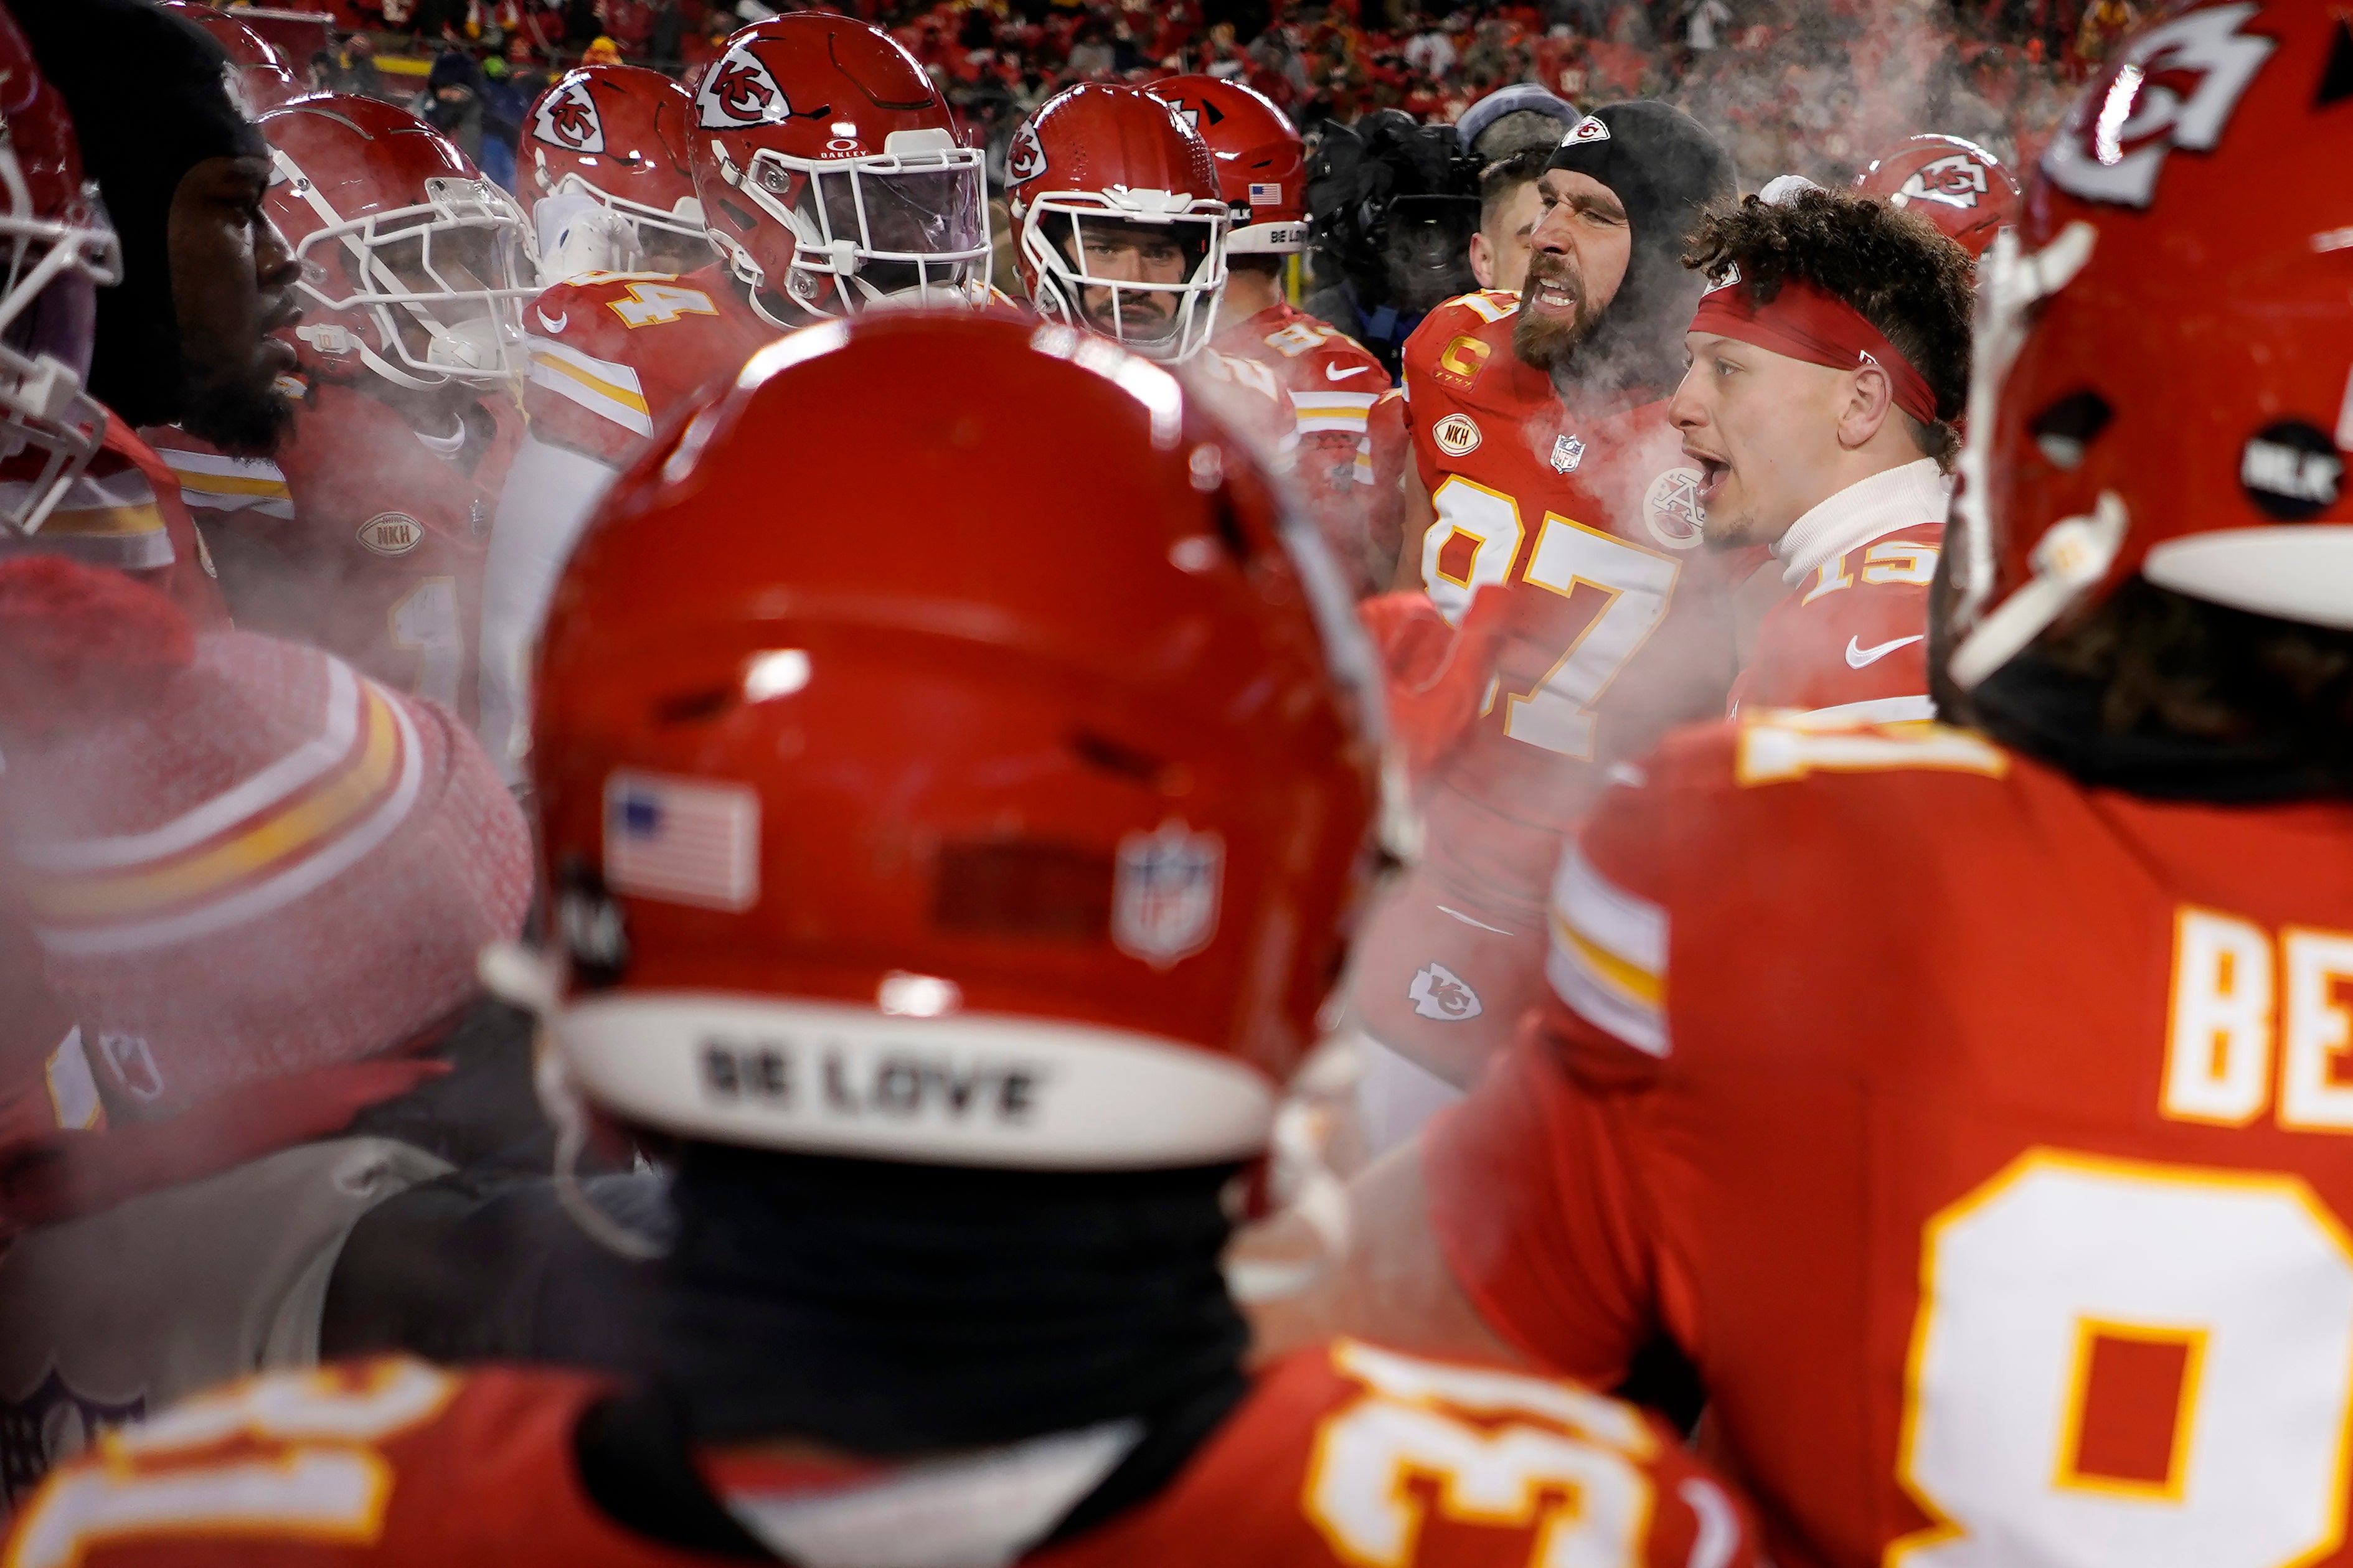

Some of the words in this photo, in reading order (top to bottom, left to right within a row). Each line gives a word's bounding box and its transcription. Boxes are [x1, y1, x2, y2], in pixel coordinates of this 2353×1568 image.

[821, 151, 867, 159] OAKLEY
[1271, 230, 1286, 243] BE
[1440, 336, 1491, 377] C
[1444, 424, 1469, 446] NKH
[377, 526, 411, 545] NKH
[697, 1038, 796, 1105] BE
[817, 1046, 1037, 1124] LOVE
